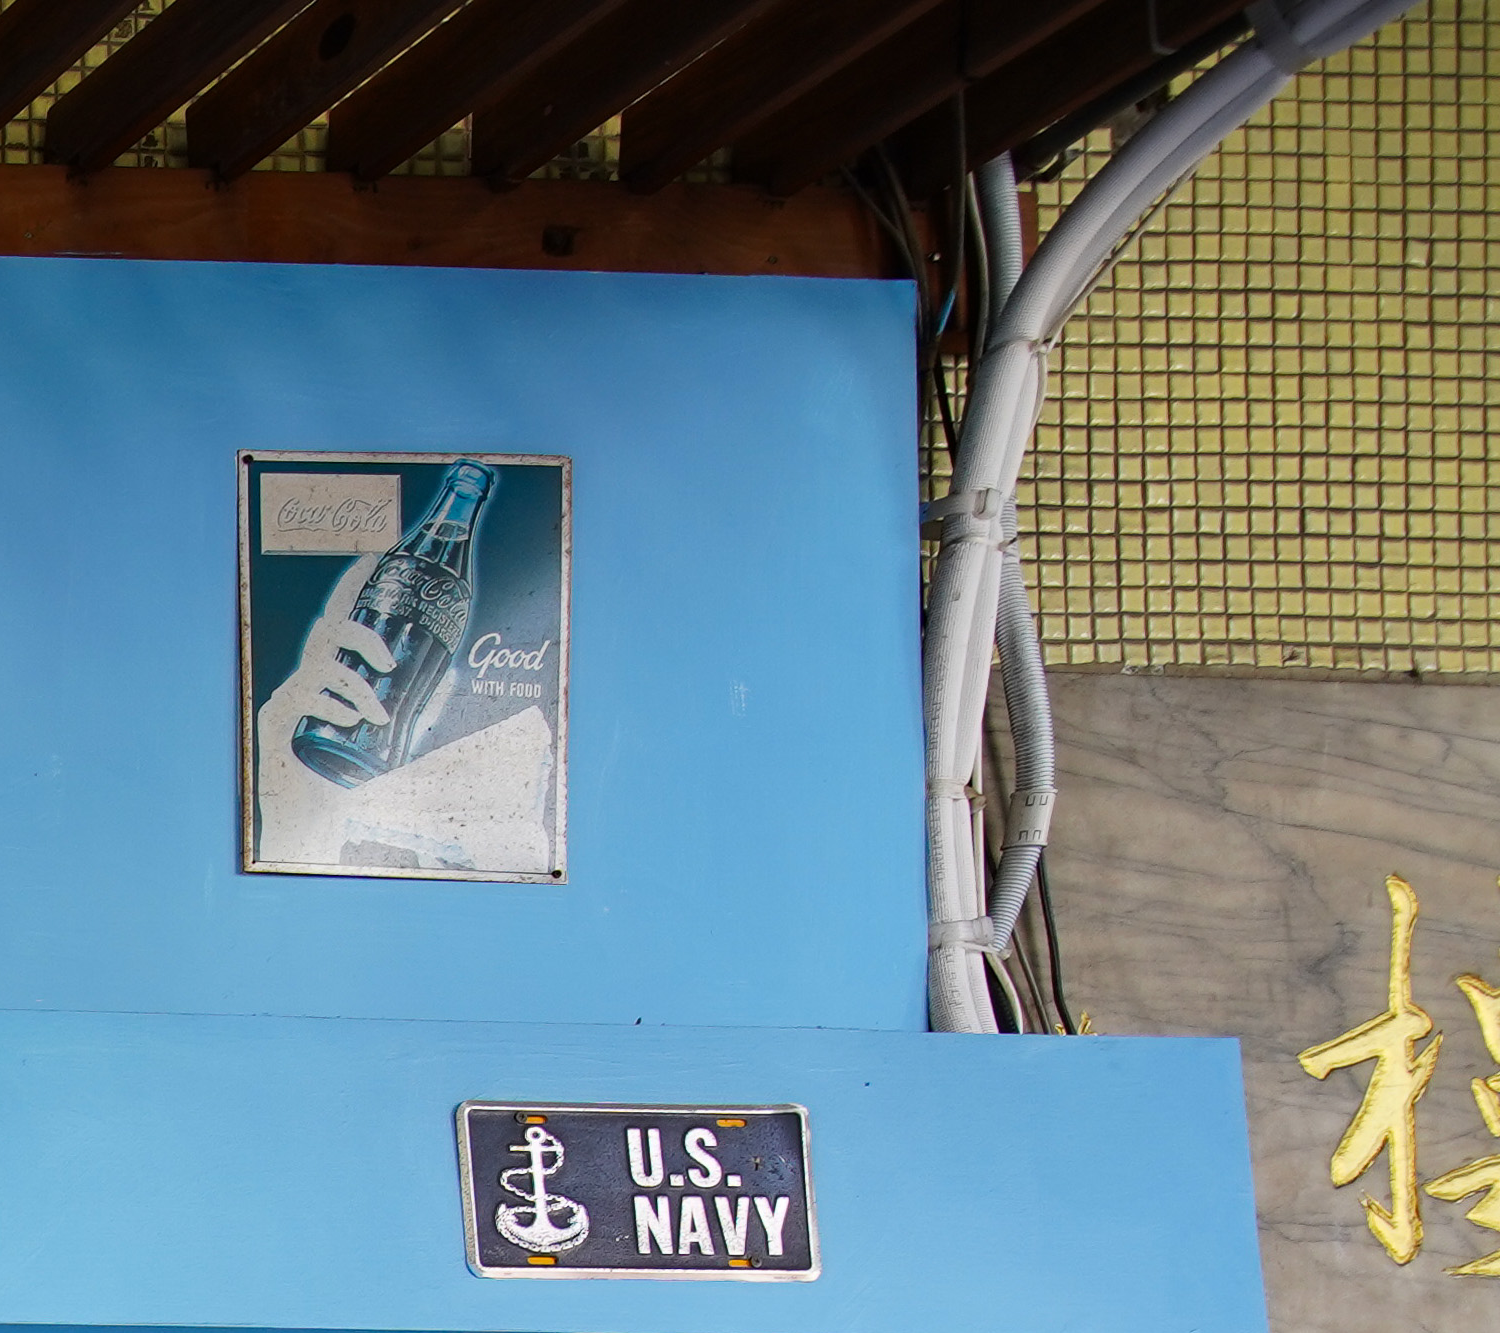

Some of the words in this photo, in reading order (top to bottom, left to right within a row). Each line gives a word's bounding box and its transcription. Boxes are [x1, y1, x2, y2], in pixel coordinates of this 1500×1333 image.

[468, 632, 550, 679] Good
[471, 679, 505, 697] WITH
[509, 682, 542, 699] FOOD
[626, 1126, 742, 1188] U.S.
[633, 1195, 790, 1256] NAVY
